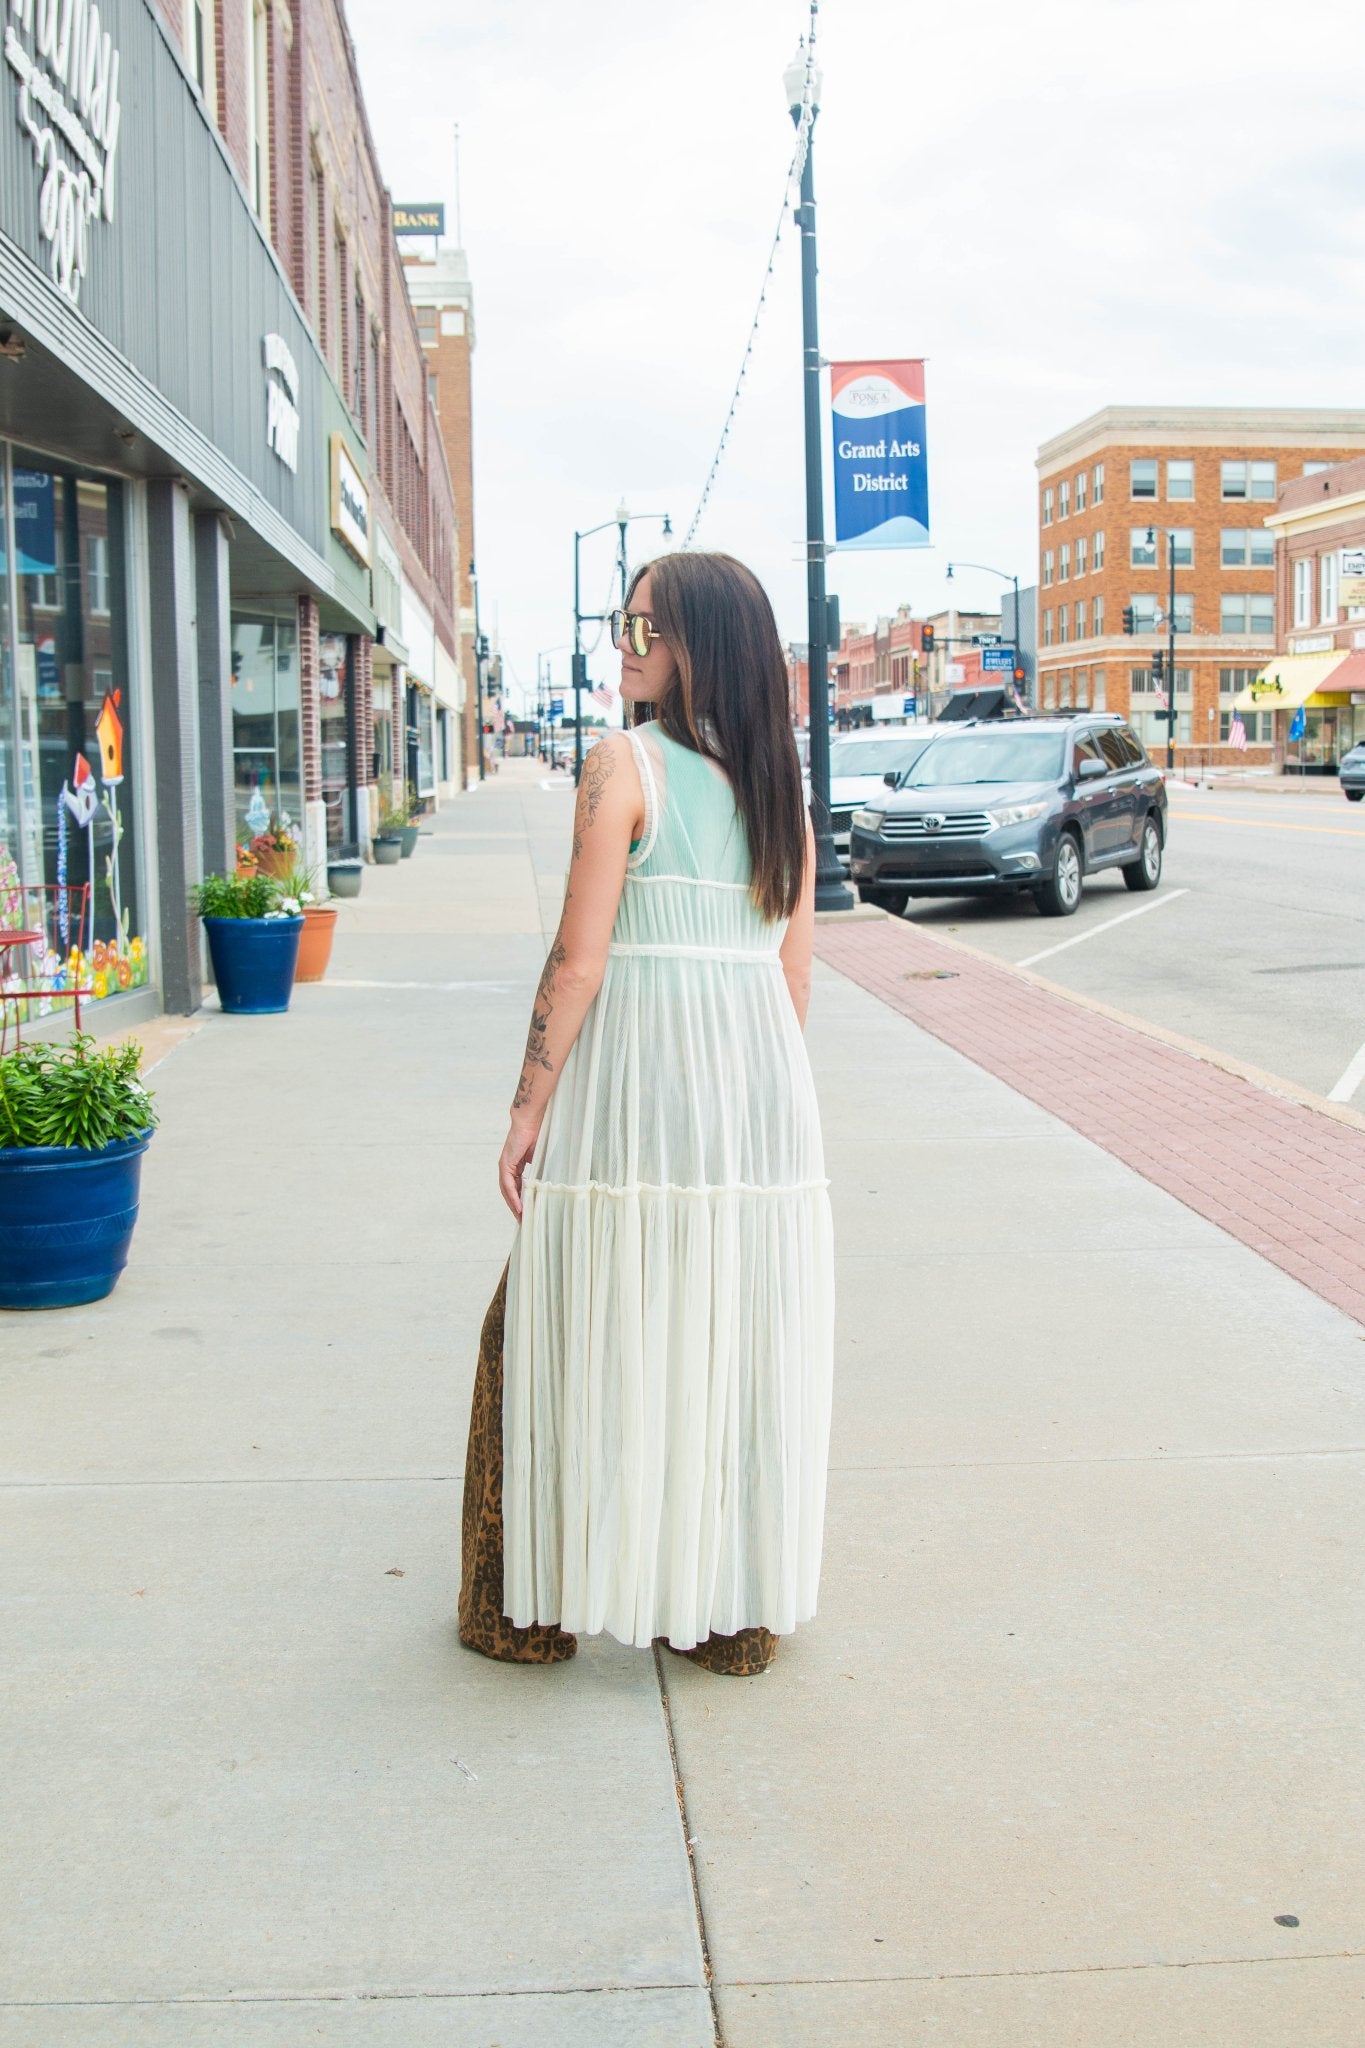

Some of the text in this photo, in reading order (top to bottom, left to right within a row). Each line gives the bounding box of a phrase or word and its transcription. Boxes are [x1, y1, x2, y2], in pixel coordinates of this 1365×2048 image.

[839, 440, 920, 459] Grand Arts
[853, 473, 908, 492] District
